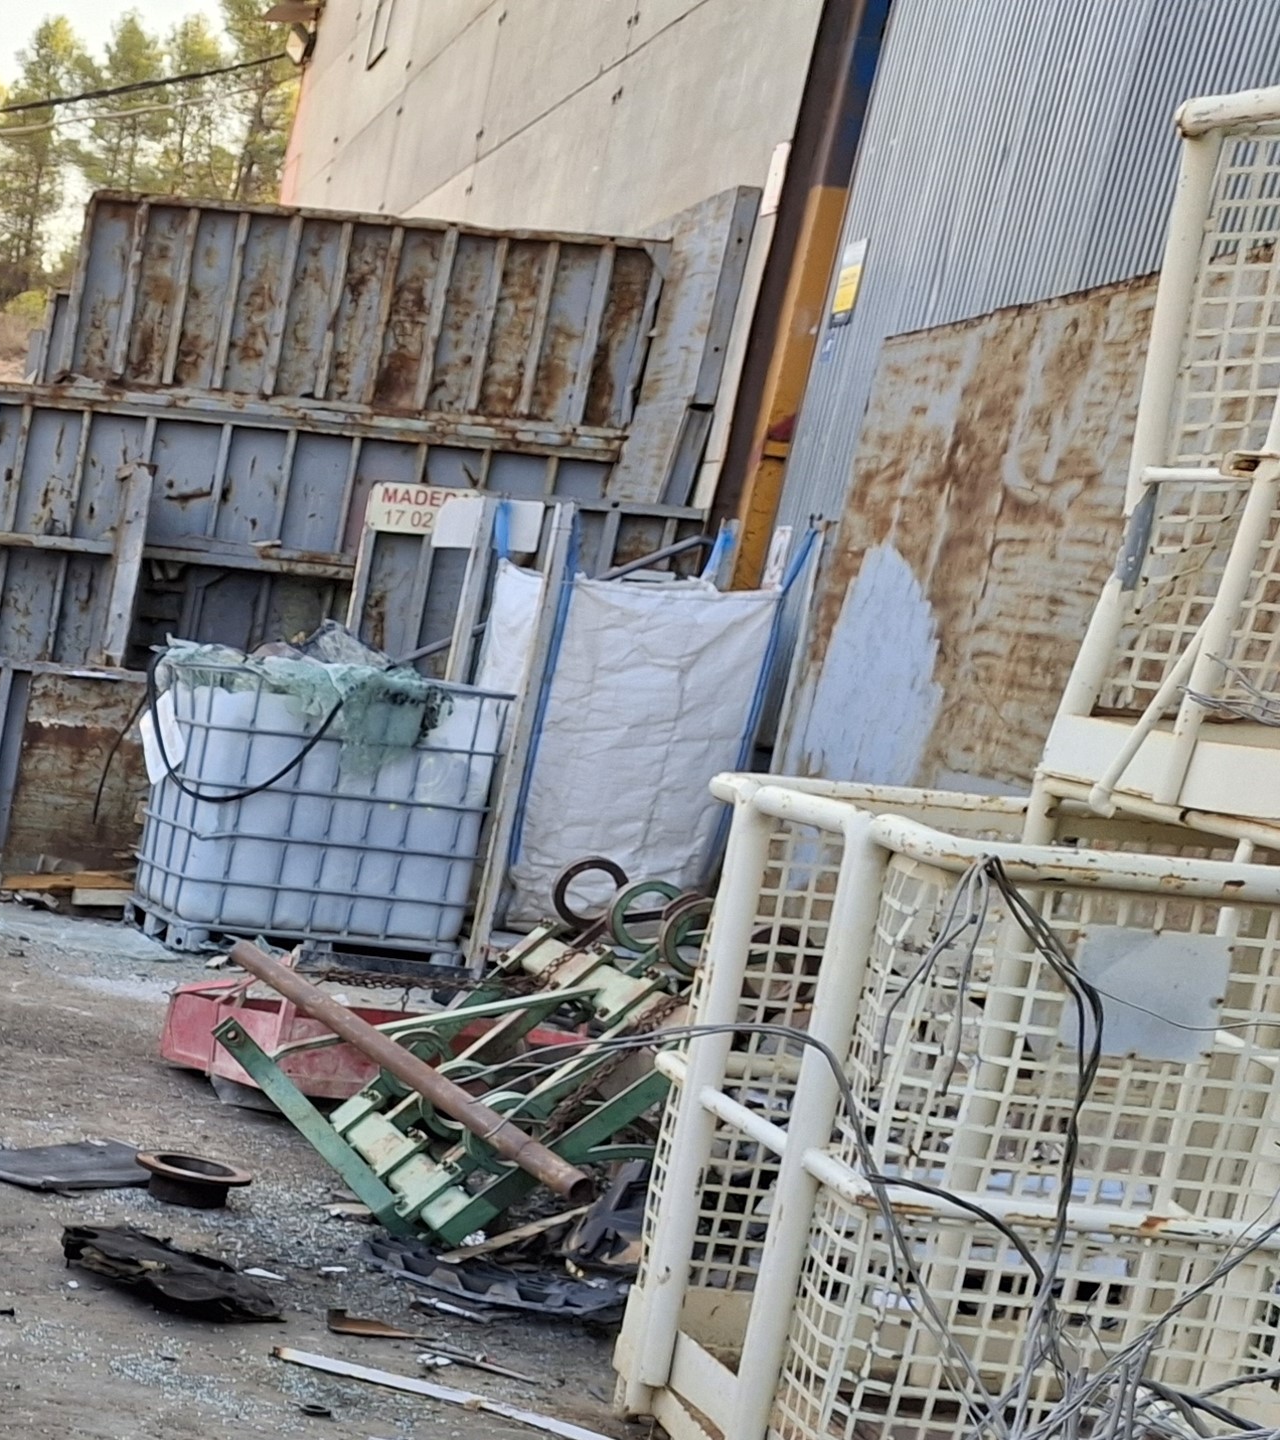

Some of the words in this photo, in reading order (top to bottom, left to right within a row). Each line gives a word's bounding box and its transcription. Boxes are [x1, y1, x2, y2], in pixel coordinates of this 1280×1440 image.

[382, 487, 470, 507] MADE
[384, 509, 405, 526] 17
[410, 511, 434, 528] 02
